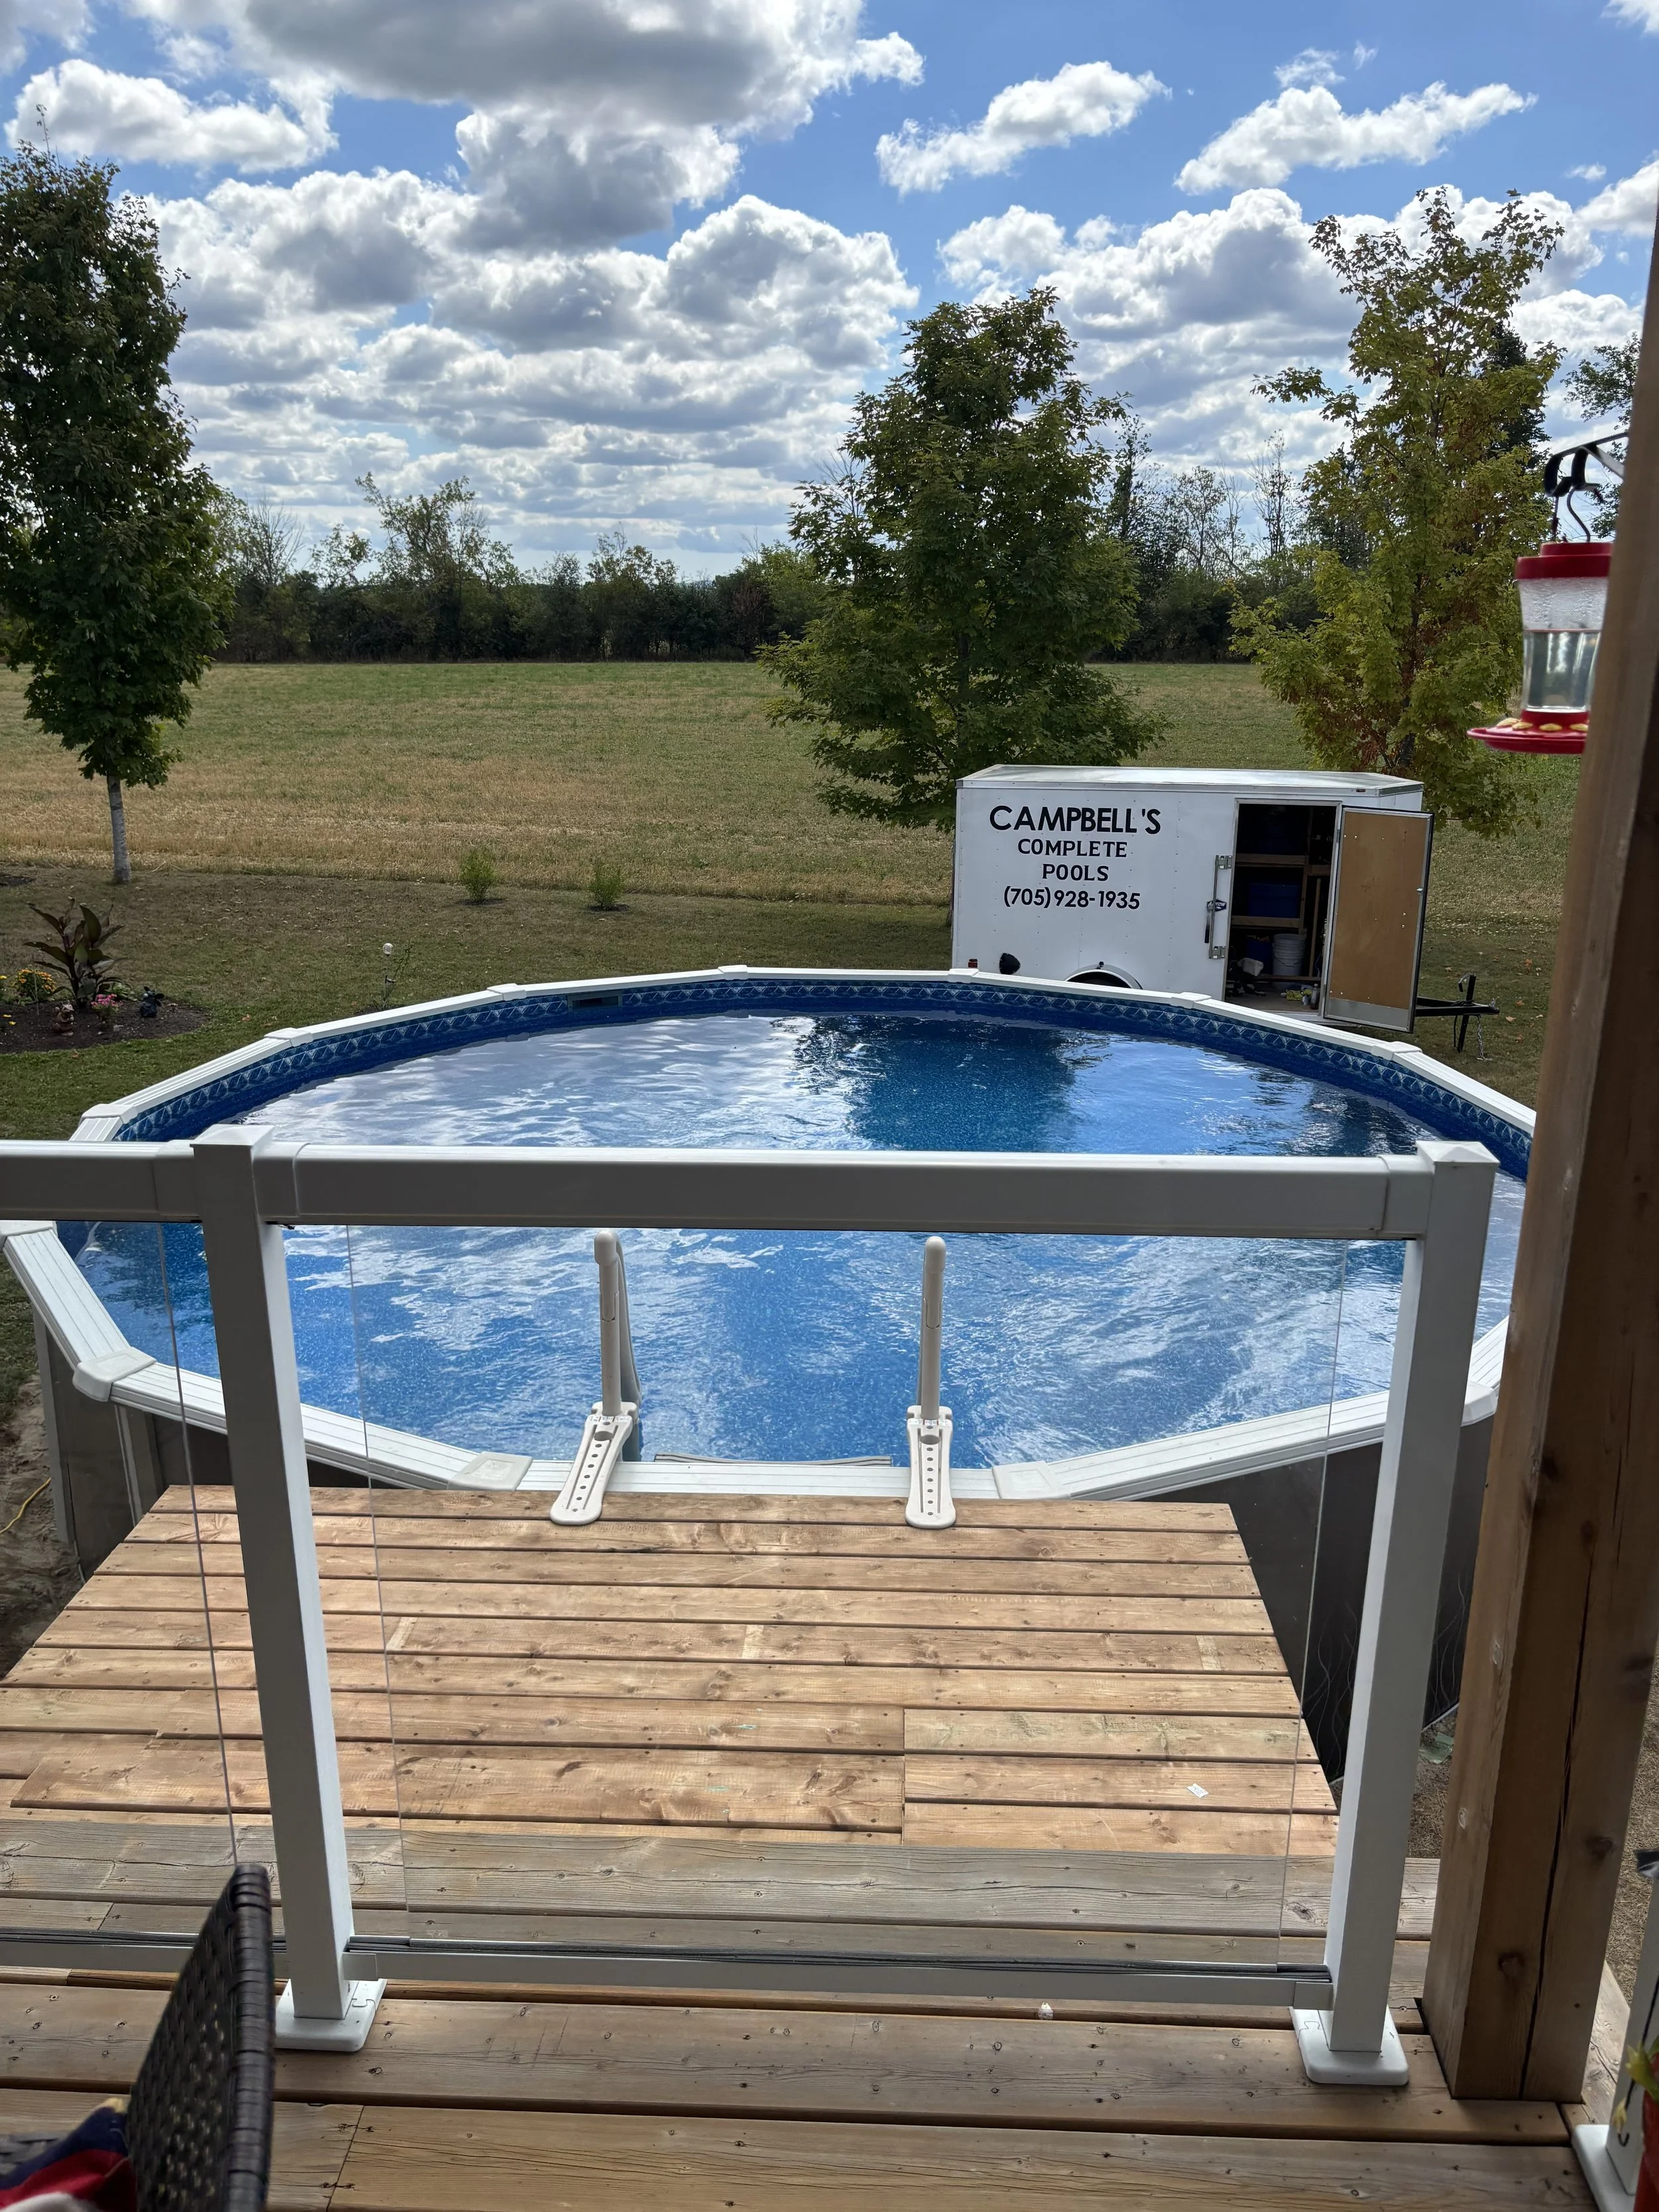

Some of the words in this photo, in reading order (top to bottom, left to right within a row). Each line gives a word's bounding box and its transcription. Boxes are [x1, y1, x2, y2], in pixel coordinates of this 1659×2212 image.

[989, 805, 1161, 835] CAMPBELL'S
[1017, 838, 1127, 857] COMPLETE
[1042, 863, 1109, 881] POOLS
